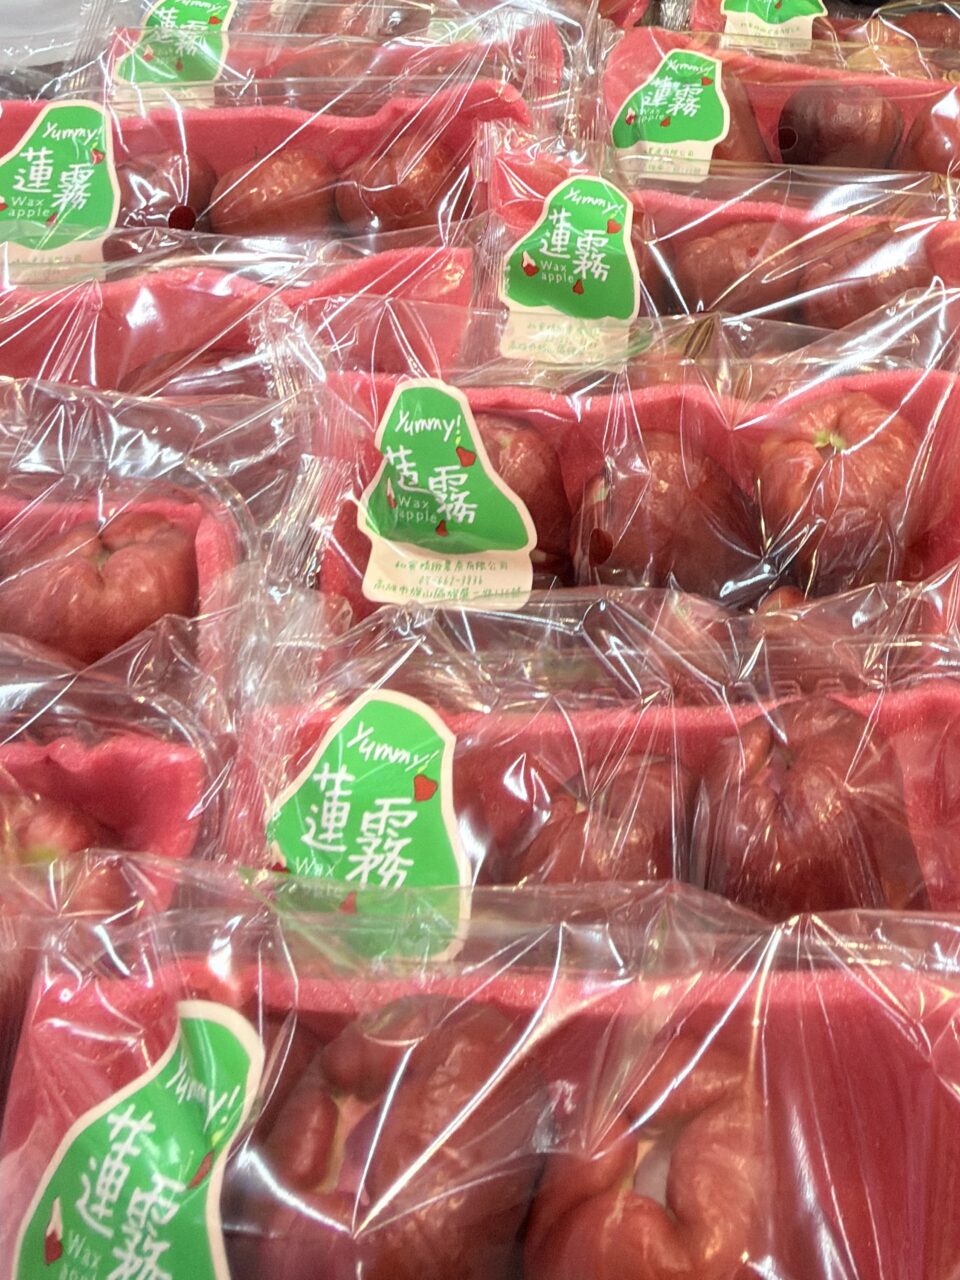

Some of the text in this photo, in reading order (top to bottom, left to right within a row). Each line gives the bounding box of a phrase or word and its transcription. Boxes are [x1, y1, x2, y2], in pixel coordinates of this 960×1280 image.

[43, 122, 104, 146] Yummy!
[12, 147, 94, 210] 蓮霧
[564, 187, 625, 215] Yummy!
[539, 207, 611, 282] 蓮霧
[395, 409, 462, 442] Yummy!
[347, 721, 440, 773] Yummy!
[301, 762, 417, 897] 蓮霧
